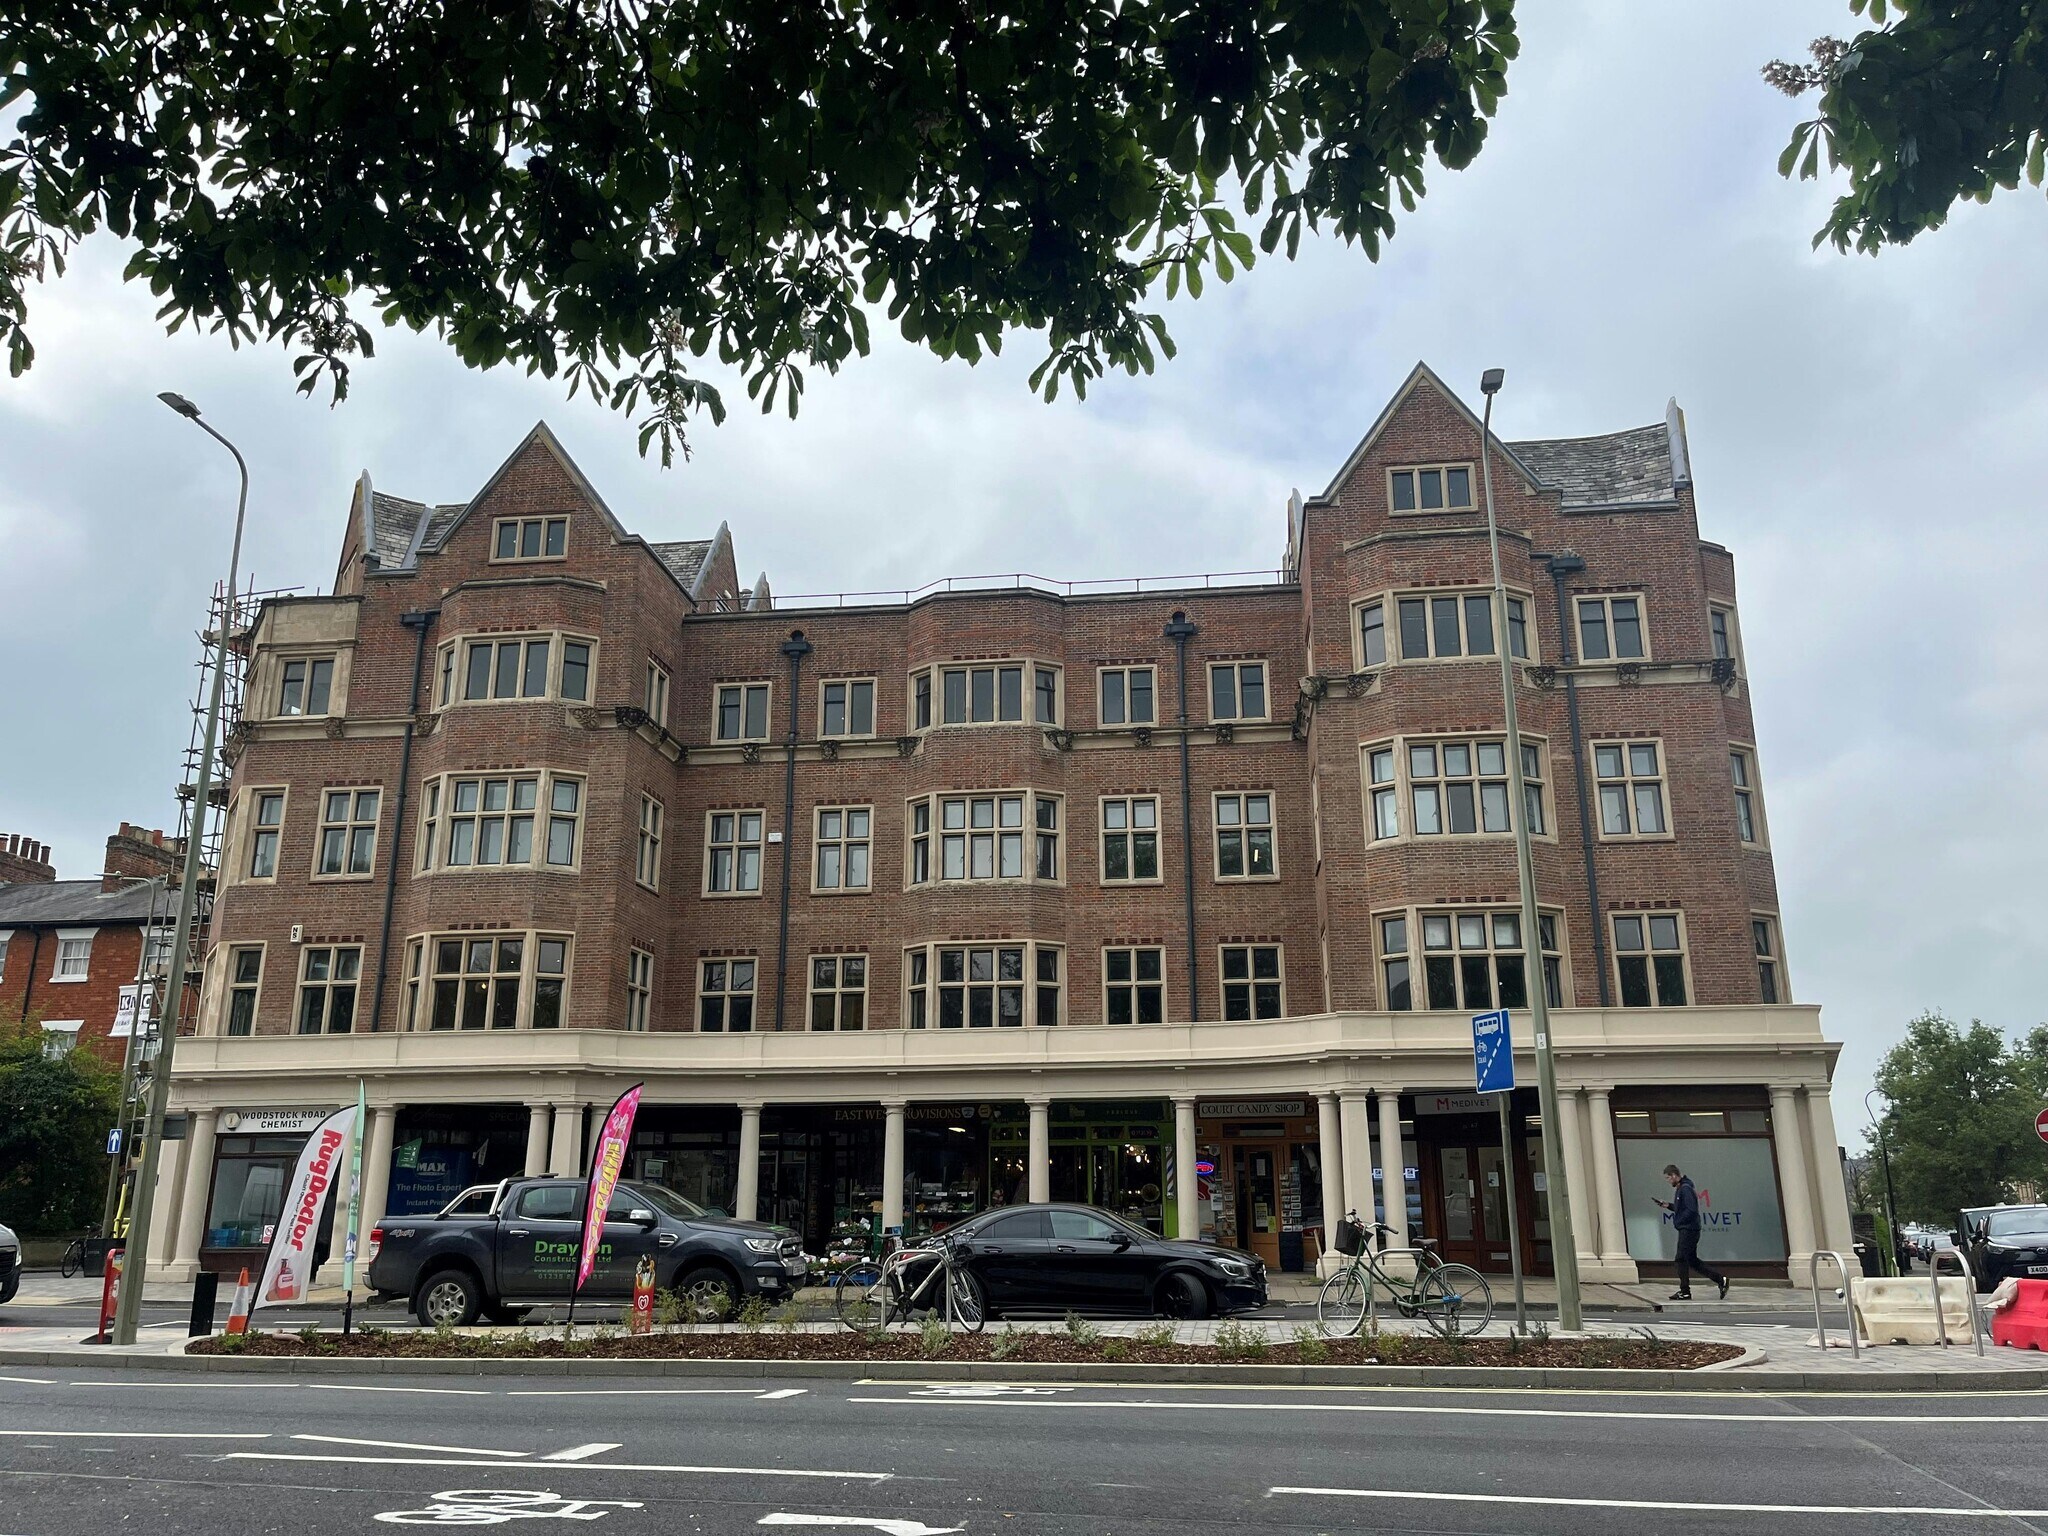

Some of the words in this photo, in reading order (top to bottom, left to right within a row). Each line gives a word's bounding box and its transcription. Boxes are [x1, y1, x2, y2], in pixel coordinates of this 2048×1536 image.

[1477, 1056, 1487, 1064] taxi
[1451, 1099, 1490, 1107] MEDIVET
[1201, 1104, 1235, 1115] COURT
[1237, 1103, 1273, 1114] CANDY
[1274, 1103, 1300, 1113] SHOP
[242, 1111, 298, 1120] WOODSTOCK
[301, 1110, 326, 1118] ROAD
[834, 1109, 862, 1121] EAST
[863, 1109, 886, 1120] WES
[904, 1108, 962, 1120] ROVISIONS
[261, 1120, 303, 1128] CHEMIST
[416, 1162, 447, 1172] MAX
[291, 1129, 343, 1251] RugDoctor
[396, 1183, 411, 1192] The
[1663, 1212, 1741, 1225] MIVET
[534, 1255, 577, 1263] Construc
[597, 1255, 612, 1263] Ltd
